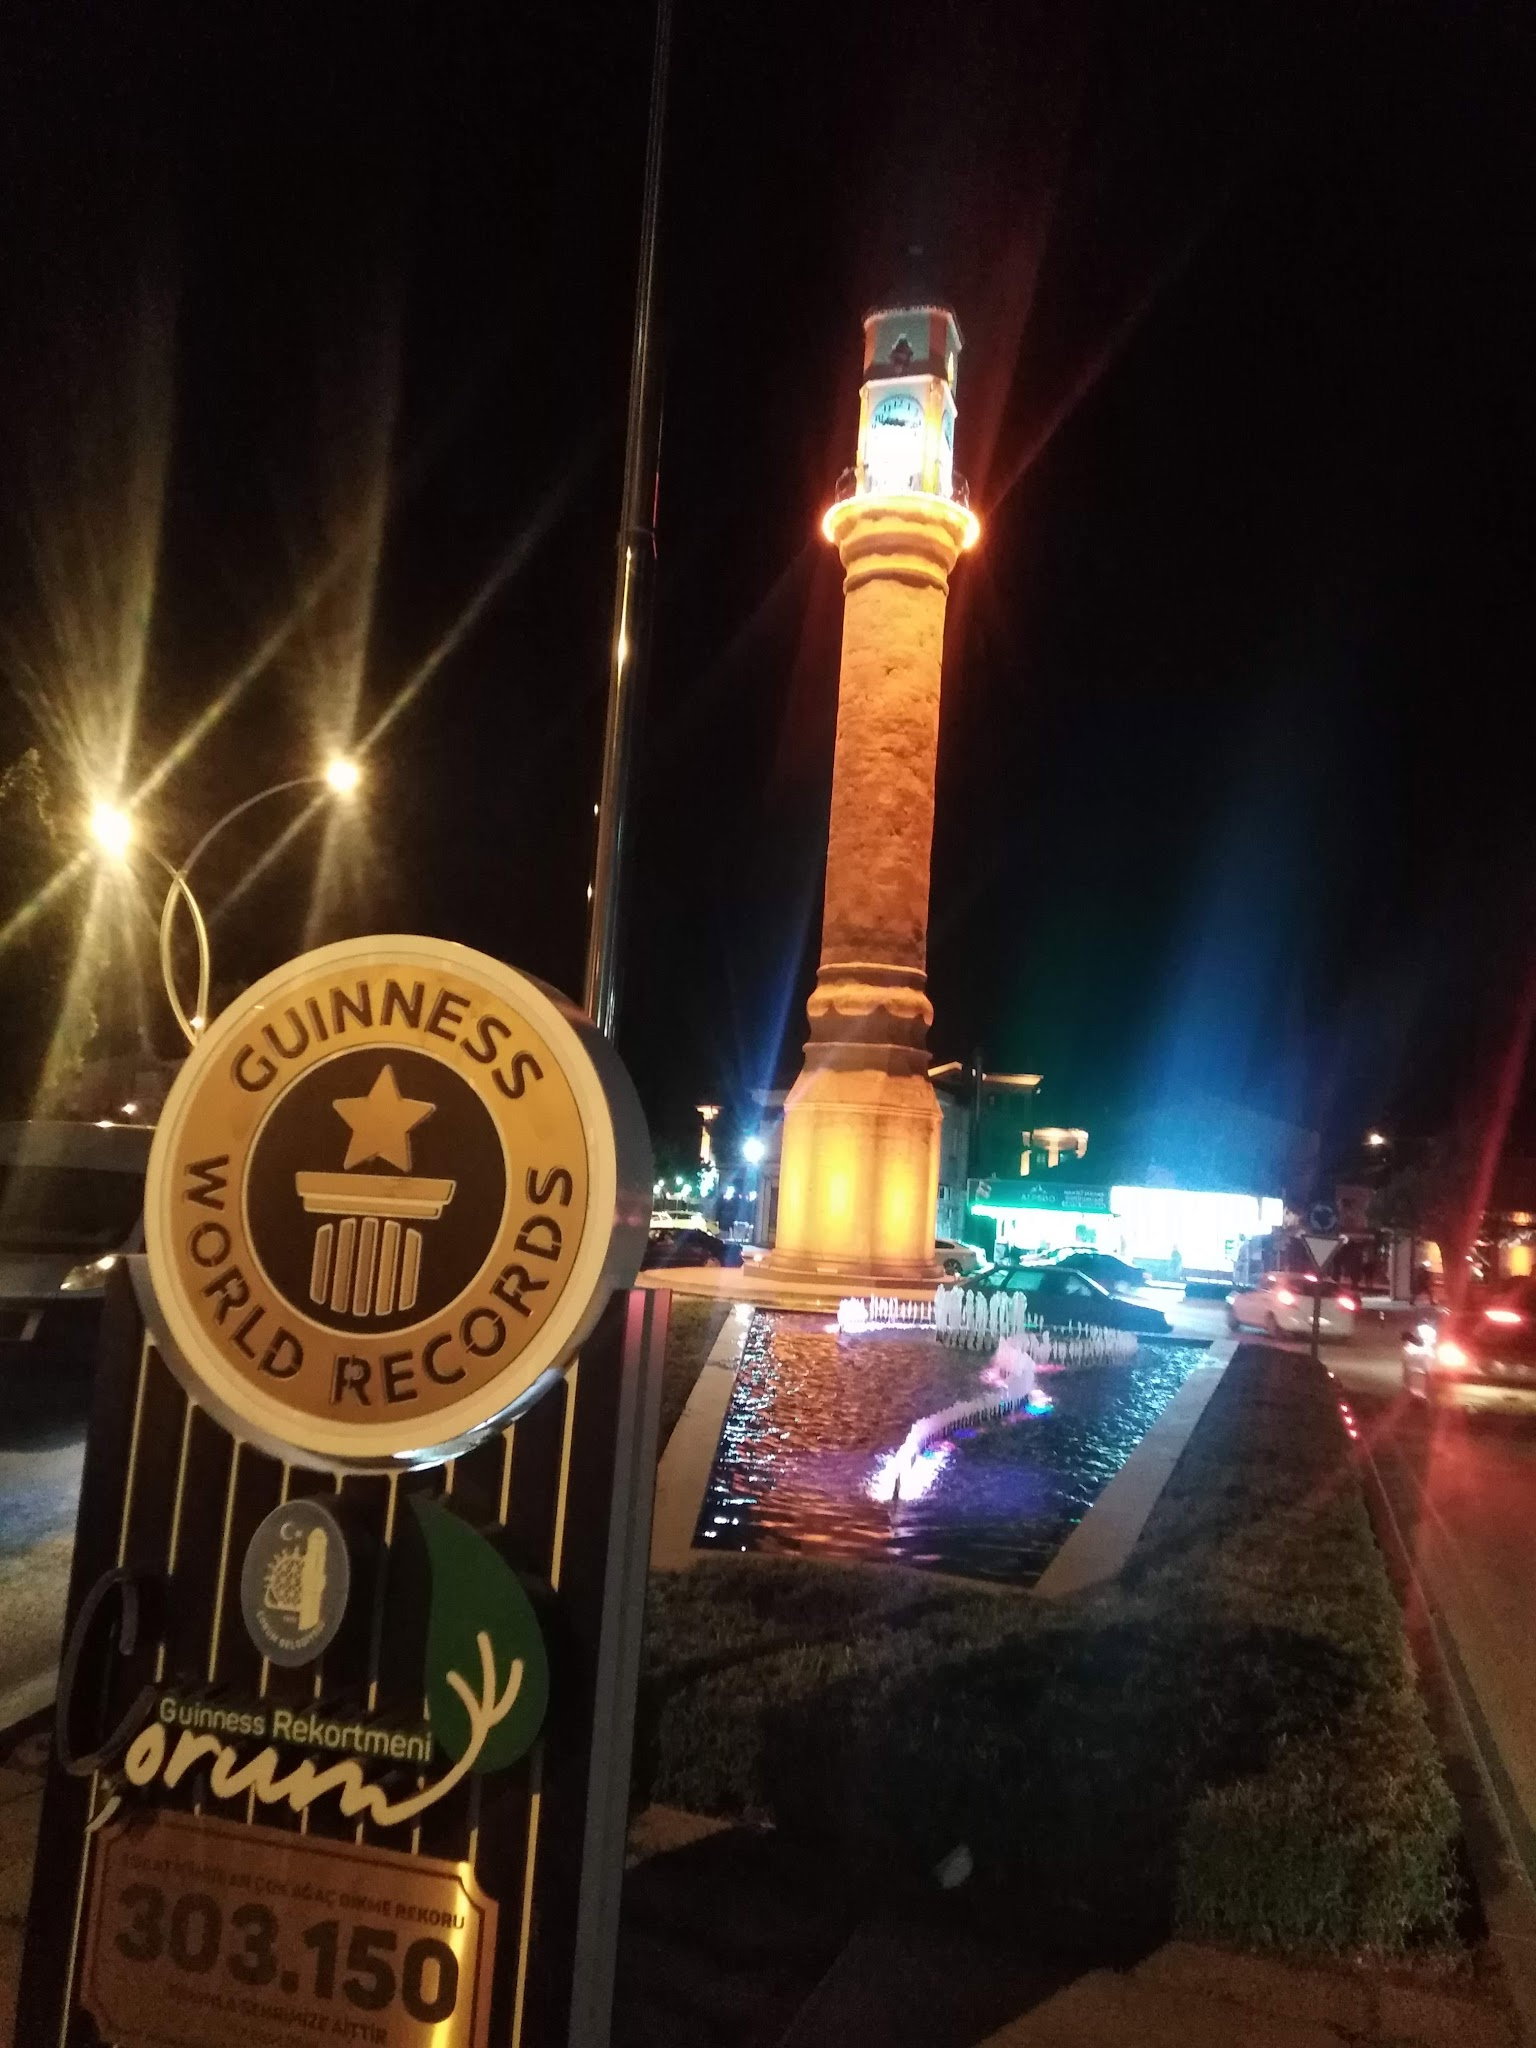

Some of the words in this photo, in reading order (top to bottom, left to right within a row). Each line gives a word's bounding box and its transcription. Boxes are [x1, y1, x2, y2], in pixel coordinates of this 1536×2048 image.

[231, 978, 544, 1100] GUINNESS
[183, 1154, 305, 1379] WORLD
[331, 1166, 573, 1405] RECORDS
[159, 1697, 266, 1736] Guinness
[272, 1709, 432, 1762] Rekortmeni
[115, 1882, 459, 2024] 303.150
[395, 1903, 465, 1930] REKORU
